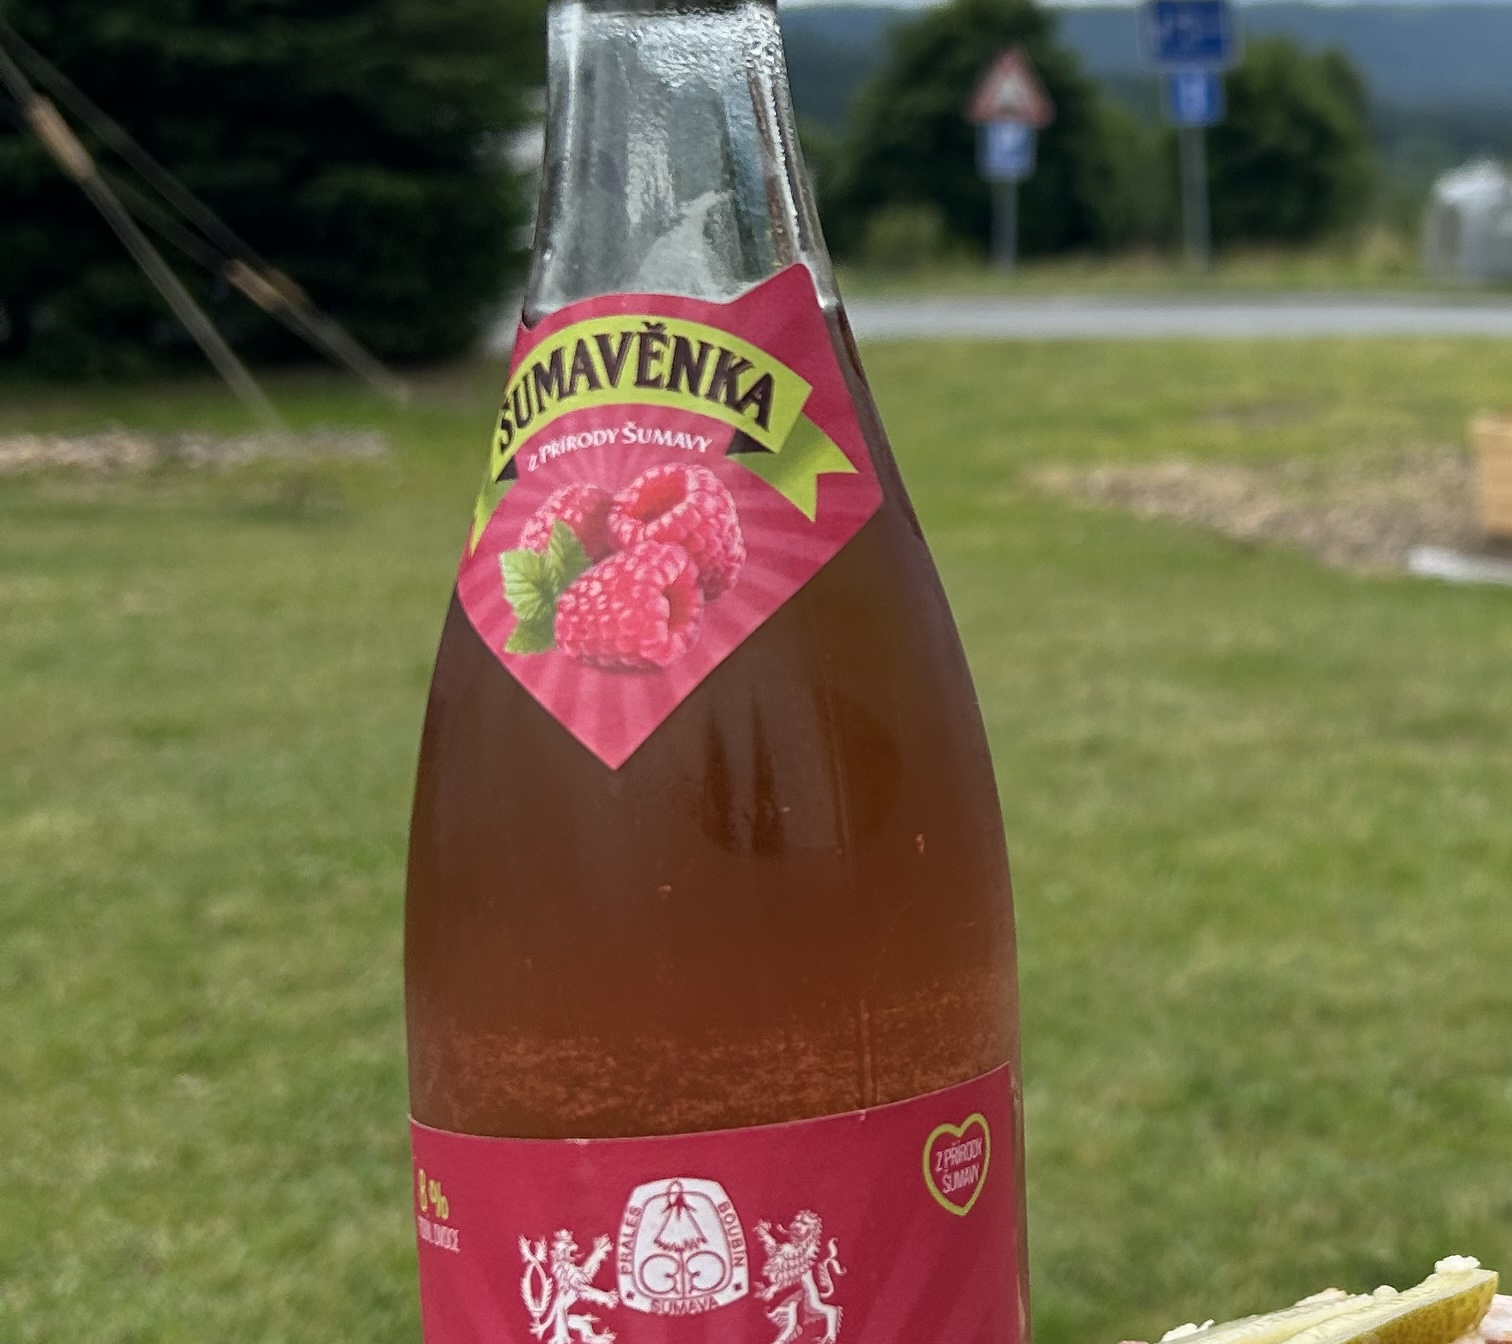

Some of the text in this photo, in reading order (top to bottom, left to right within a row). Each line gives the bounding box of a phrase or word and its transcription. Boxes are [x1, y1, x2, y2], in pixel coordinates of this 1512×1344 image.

[527, 453, 540, 473] Z
[621, 420, 713, 454] ŠUMAVY
[620, 1204, 643, 1275] PRALES
